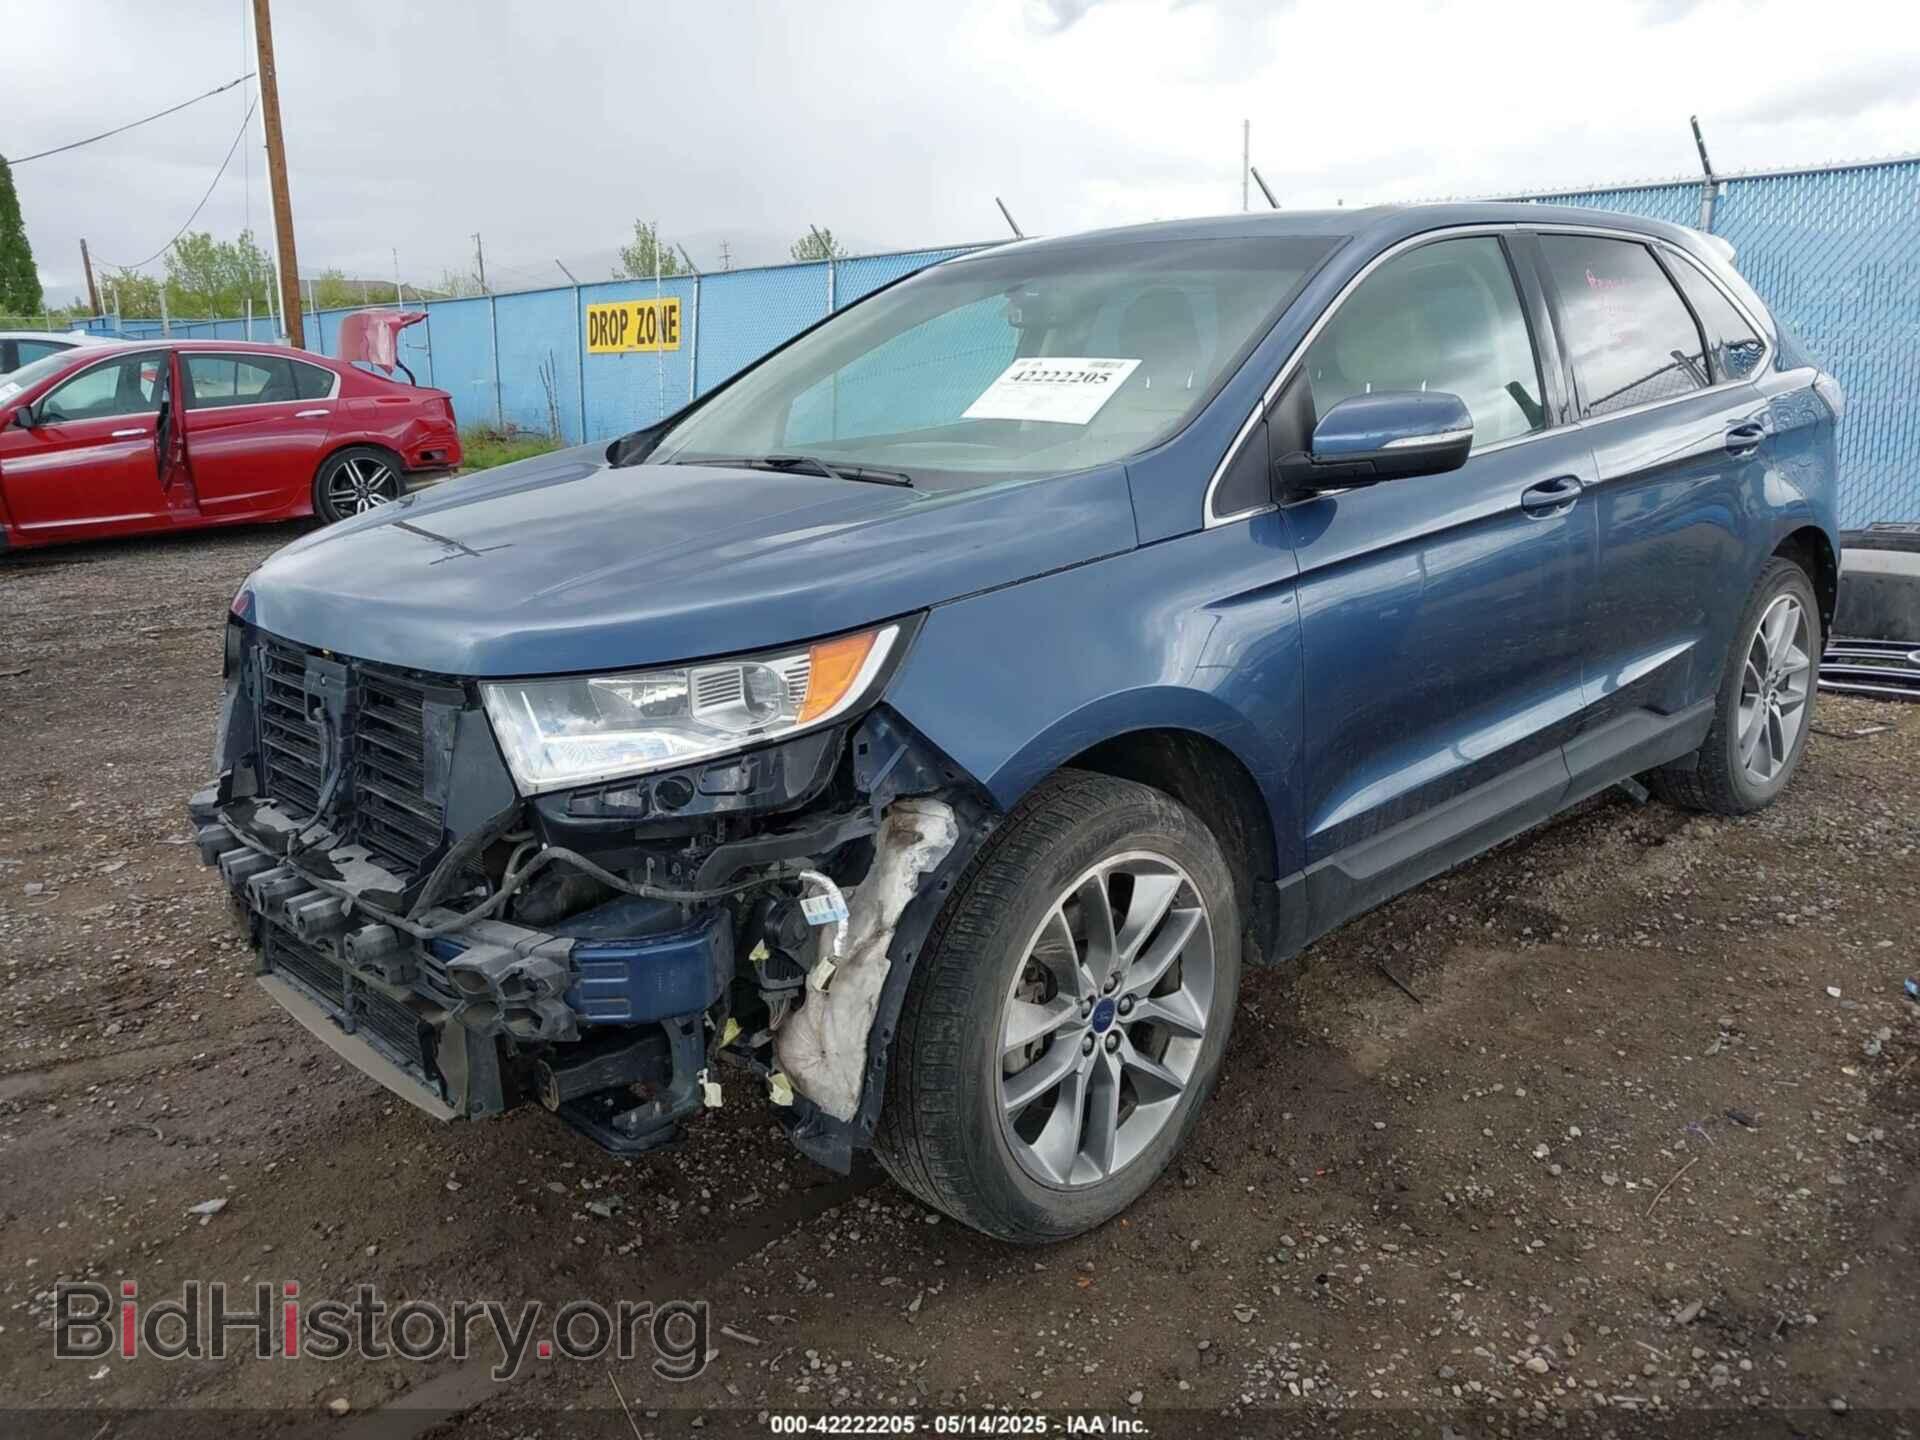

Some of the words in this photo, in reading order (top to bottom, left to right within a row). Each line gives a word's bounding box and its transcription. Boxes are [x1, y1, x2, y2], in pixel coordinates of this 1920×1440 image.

[590, 309, 627, 346] DROP
[637, 305, 677, 344] ZONE
[1010, 370, 1113, 384] 42222205
